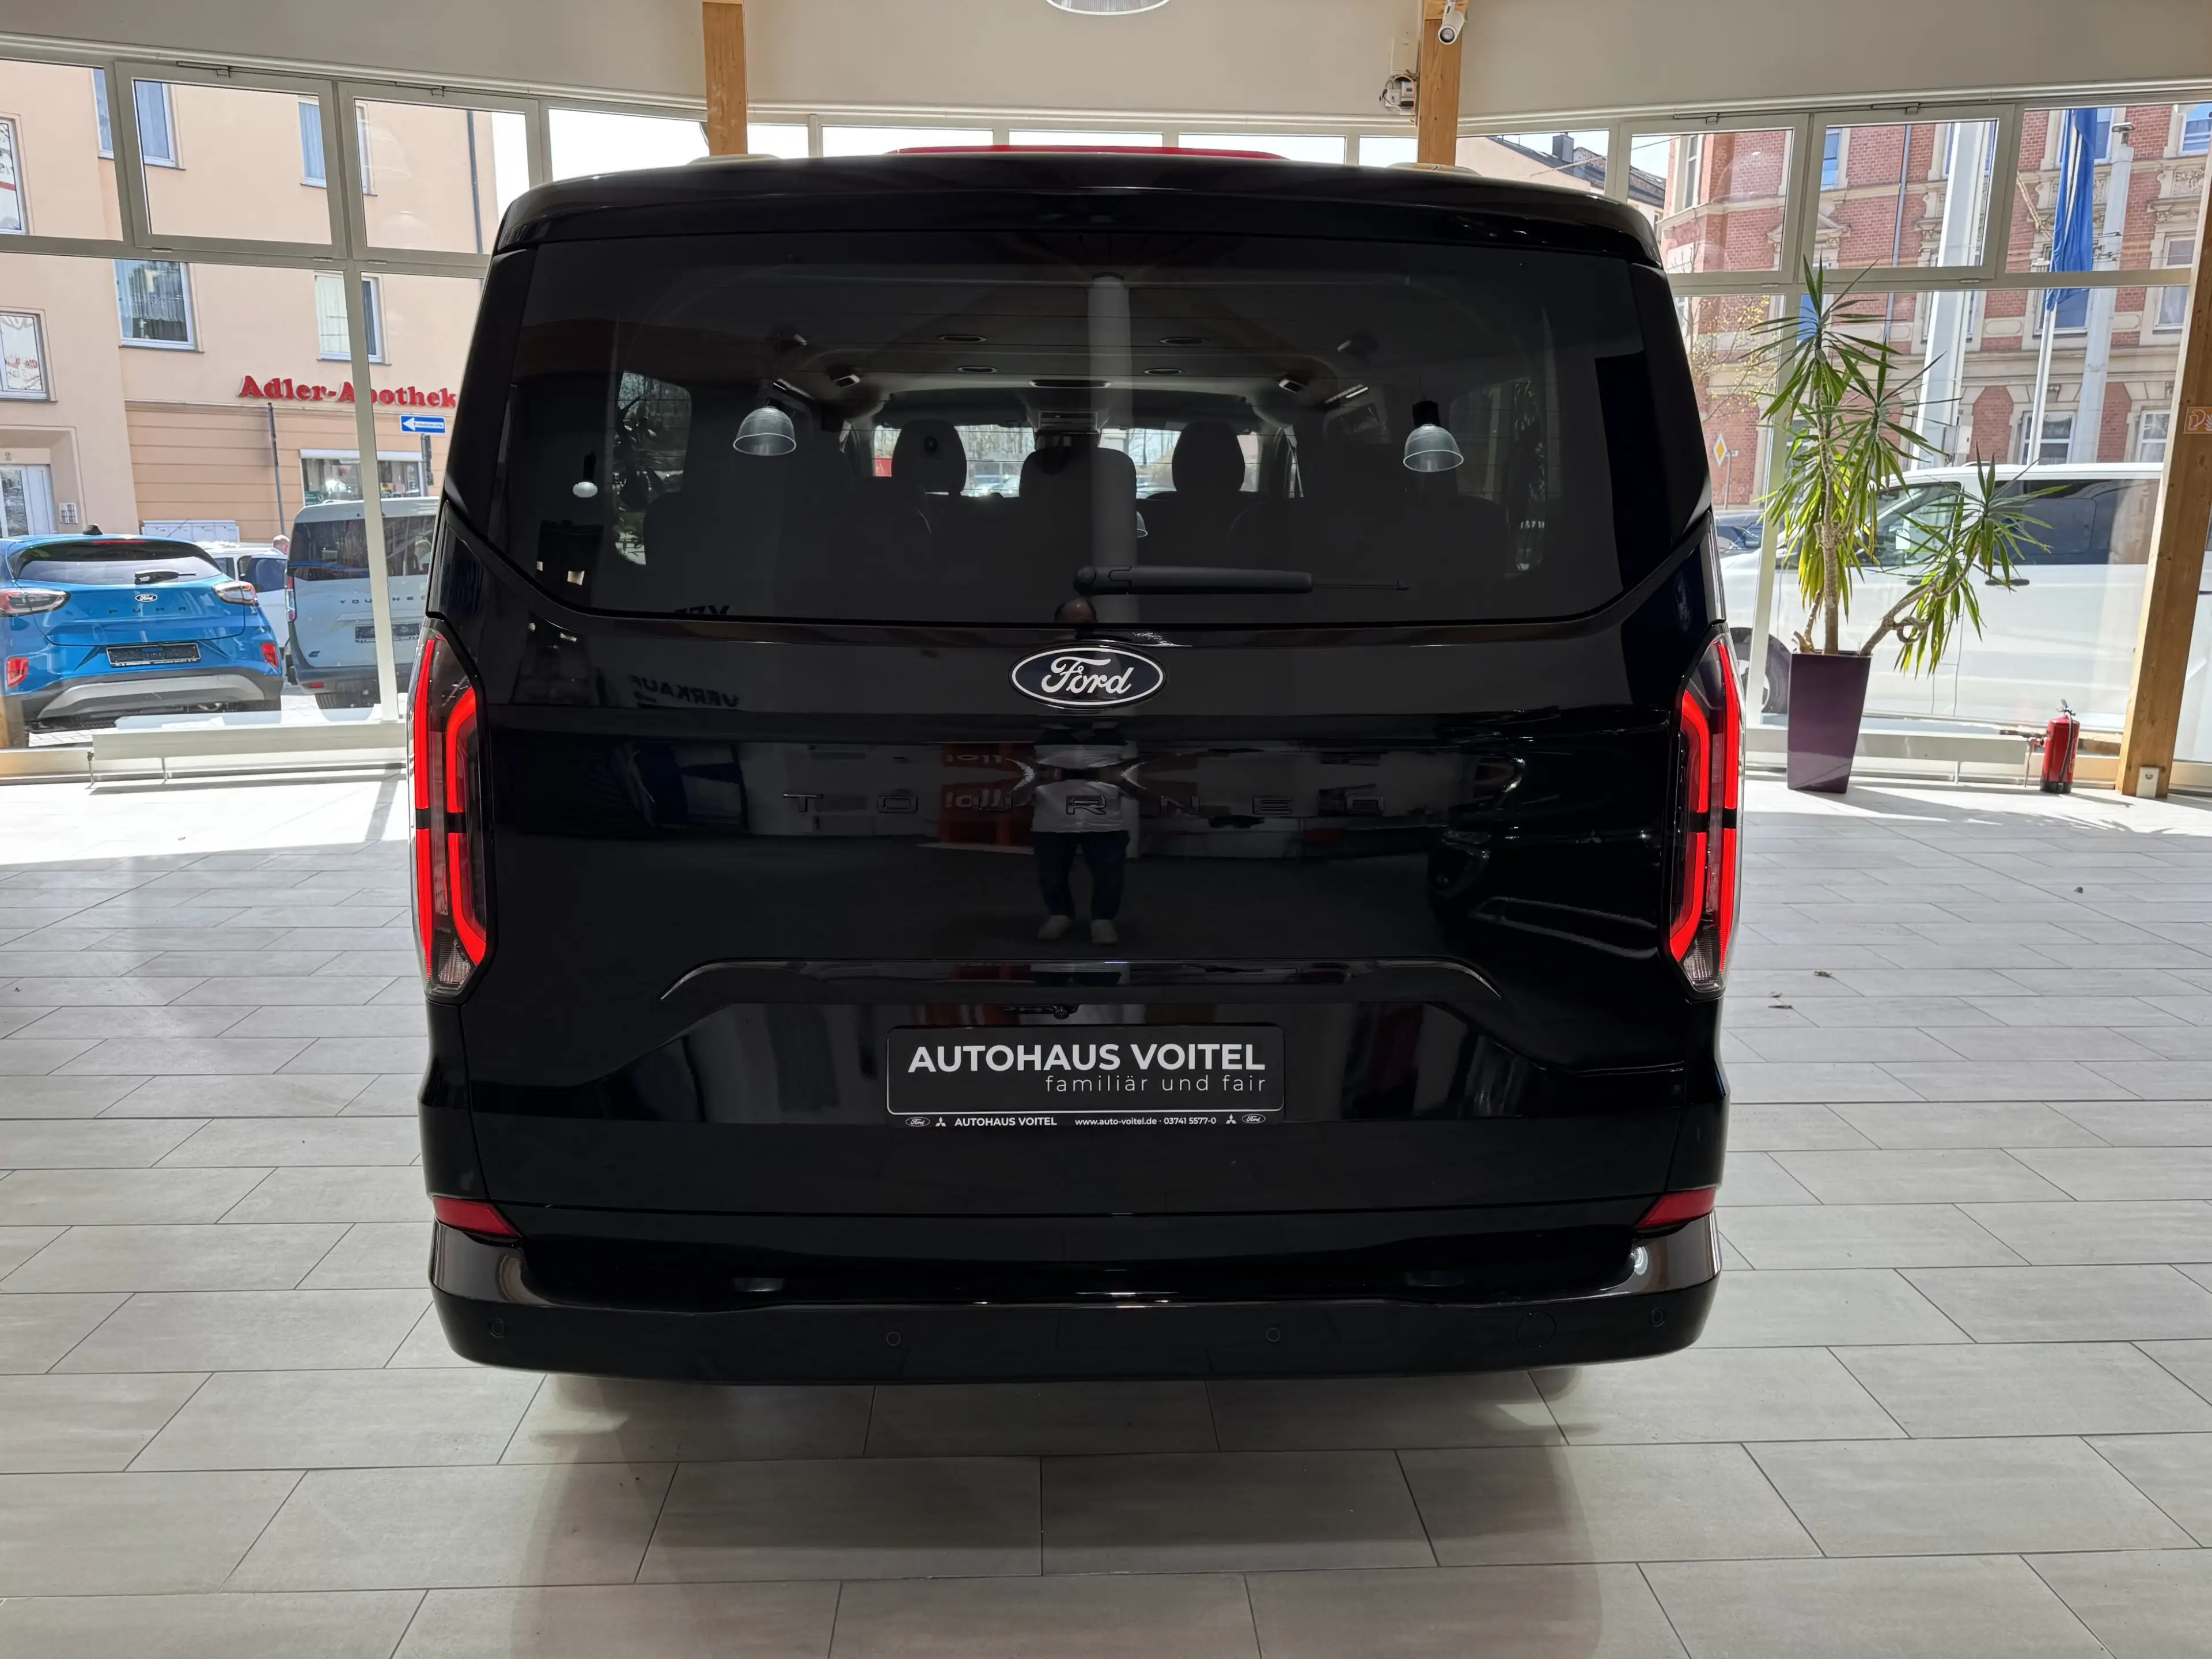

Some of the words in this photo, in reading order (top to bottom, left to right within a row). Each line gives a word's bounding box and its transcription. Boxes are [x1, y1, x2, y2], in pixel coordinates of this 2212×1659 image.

[339, 595, 426, 604] TOUNEO
[1040, 656, 1132, 695] Ford
[782, 792, 1386, 816] TOURNEO
[908, 1044, 1121, 1073] AUTOHAUS
[1129, 1043, 1266, 1070] VOITEL
[1046, 1074, 1149, 1093] familiär
[1161, 1074, 1209, 1092] und
[1222, 1074, 1266, 1092] fair
[954, 1117, 1016, 1127] AUTOHAUS
[1018, 1116, 1058, 1126] VOITEL
[1075, 1116, 1157, 1126] www.auto-voitel.de
[1163, 1116, 1187, 1125] 03741
[1188, 1116, 1217, 1124] 5577-0
